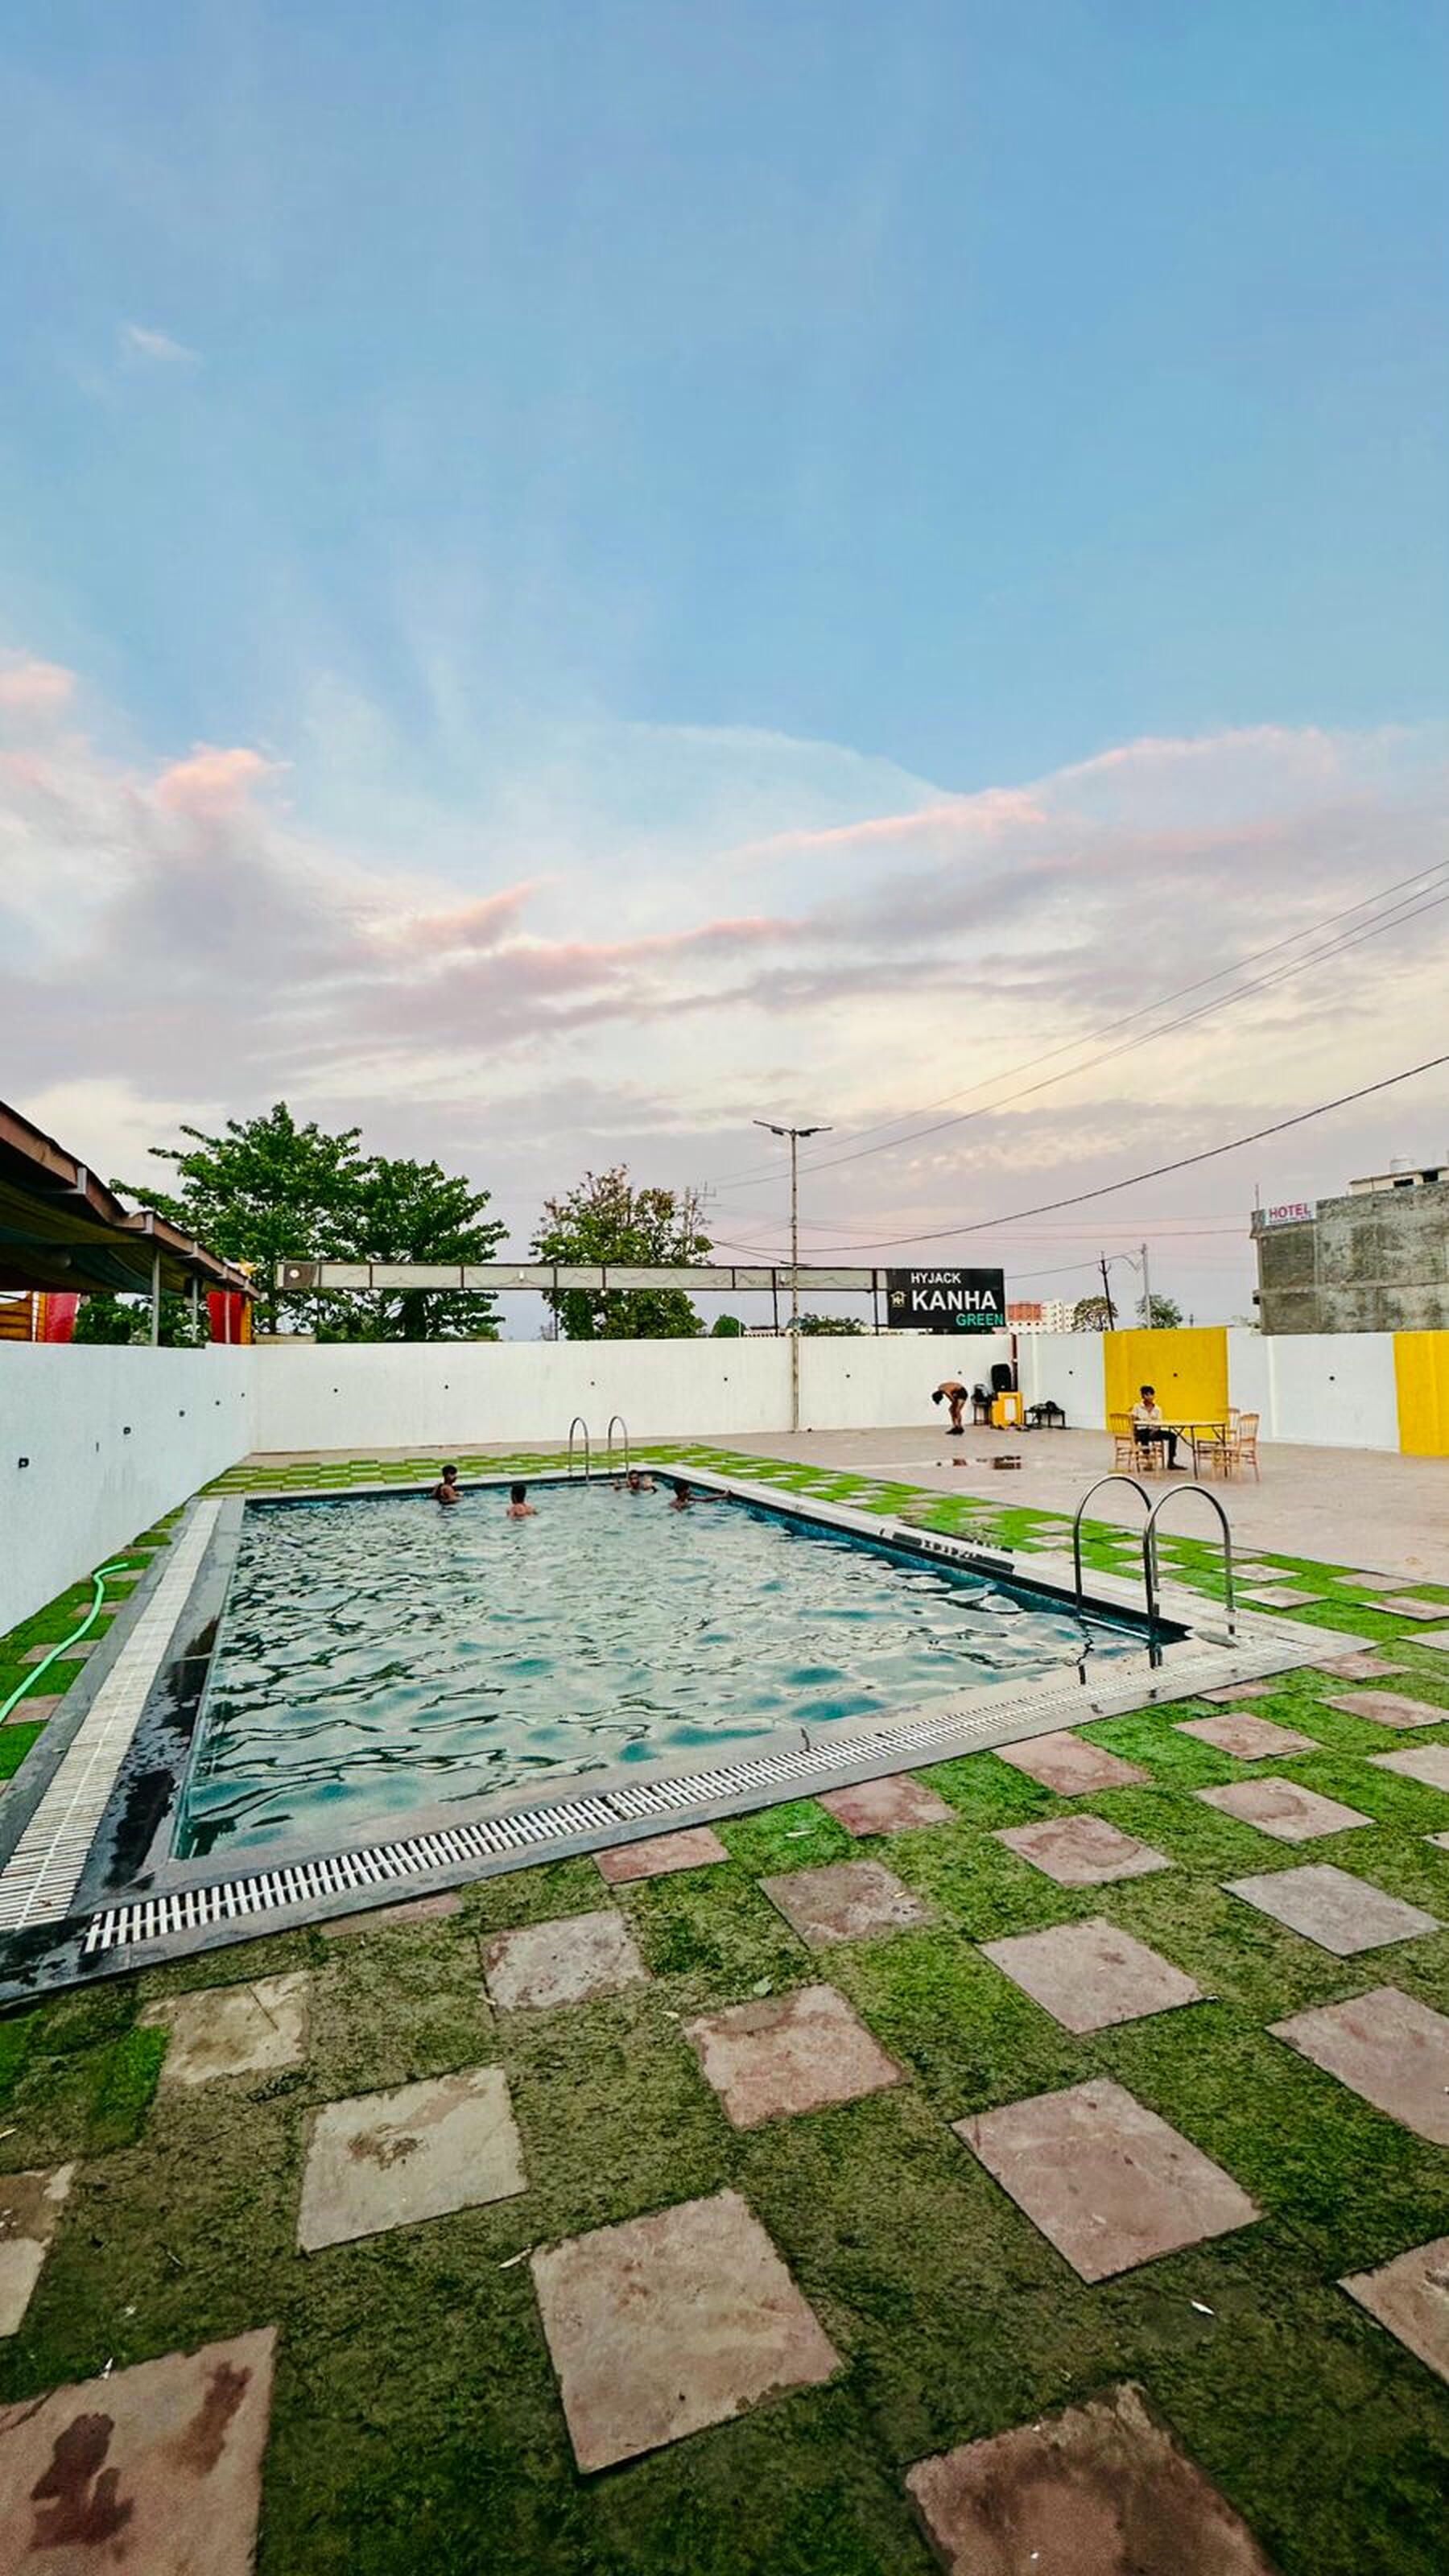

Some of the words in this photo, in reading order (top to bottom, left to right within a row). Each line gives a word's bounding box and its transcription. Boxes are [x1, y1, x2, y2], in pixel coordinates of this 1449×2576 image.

[1269, 1203, 1311, 1218] HOTEL
[910, 1272, 961, 1284] HYJACK
[912, 1290, 997, 1311] KANHA
[956, 1313, 1004, 1327] GREEN
